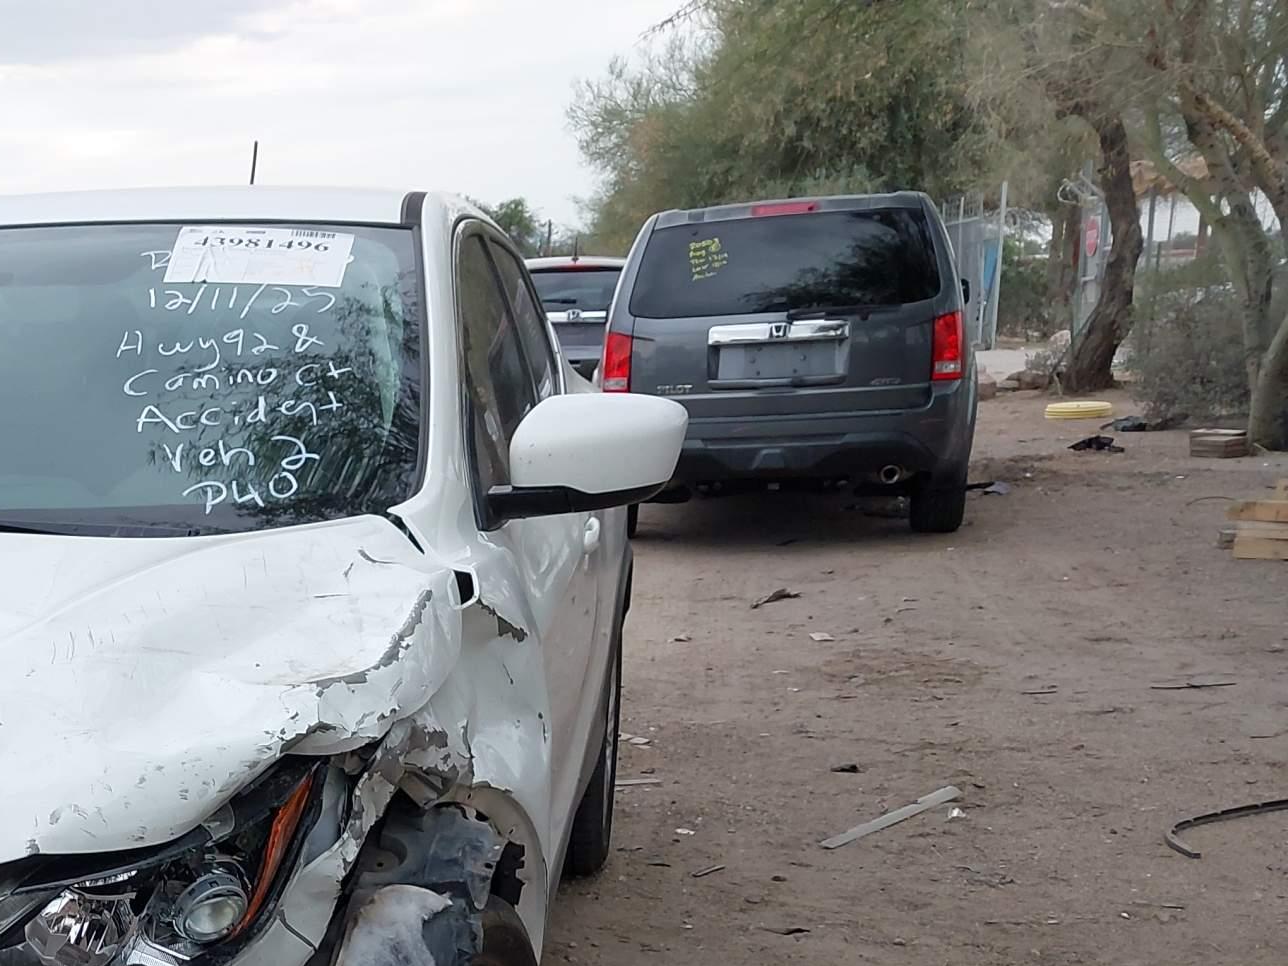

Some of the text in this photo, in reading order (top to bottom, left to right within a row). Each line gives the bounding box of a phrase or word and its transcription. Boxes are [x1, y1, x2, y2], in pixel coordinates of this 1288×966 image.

[193, 235, 330, 252] 43981496
[148, 283, 337, 319] 12/11/25
[291, 323, 326, 353] &
[122, 367, 278, 396] Camino
[270, 435, 321, 470] 2
